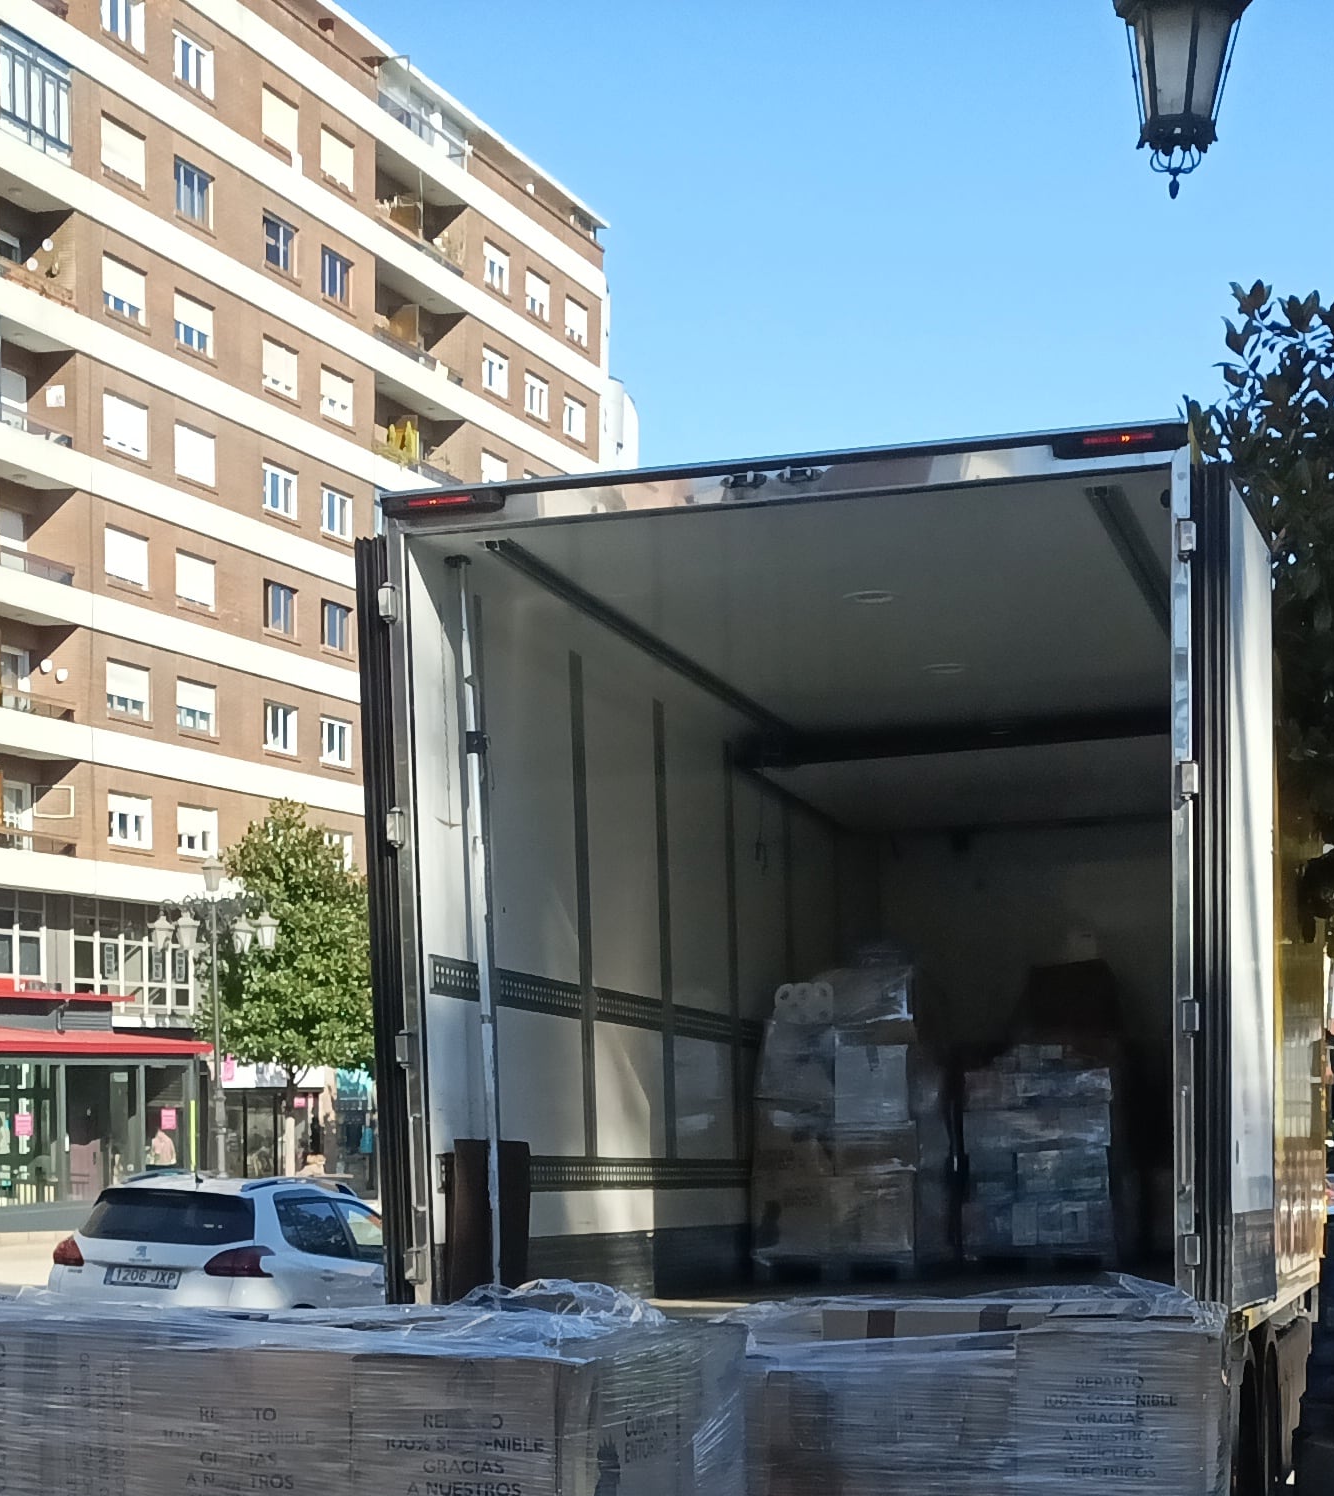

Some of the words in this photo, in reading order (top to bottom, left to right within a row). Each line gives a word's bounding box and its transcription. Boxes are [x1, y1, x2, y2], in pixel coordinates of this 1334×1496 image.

[117, 1269, 146, 1281] 1206
[151, 1270, 176, 1283] JXP
[423, 1459, 505, 1474] GRACIAS
[408, 1483, 419, 1496] A
